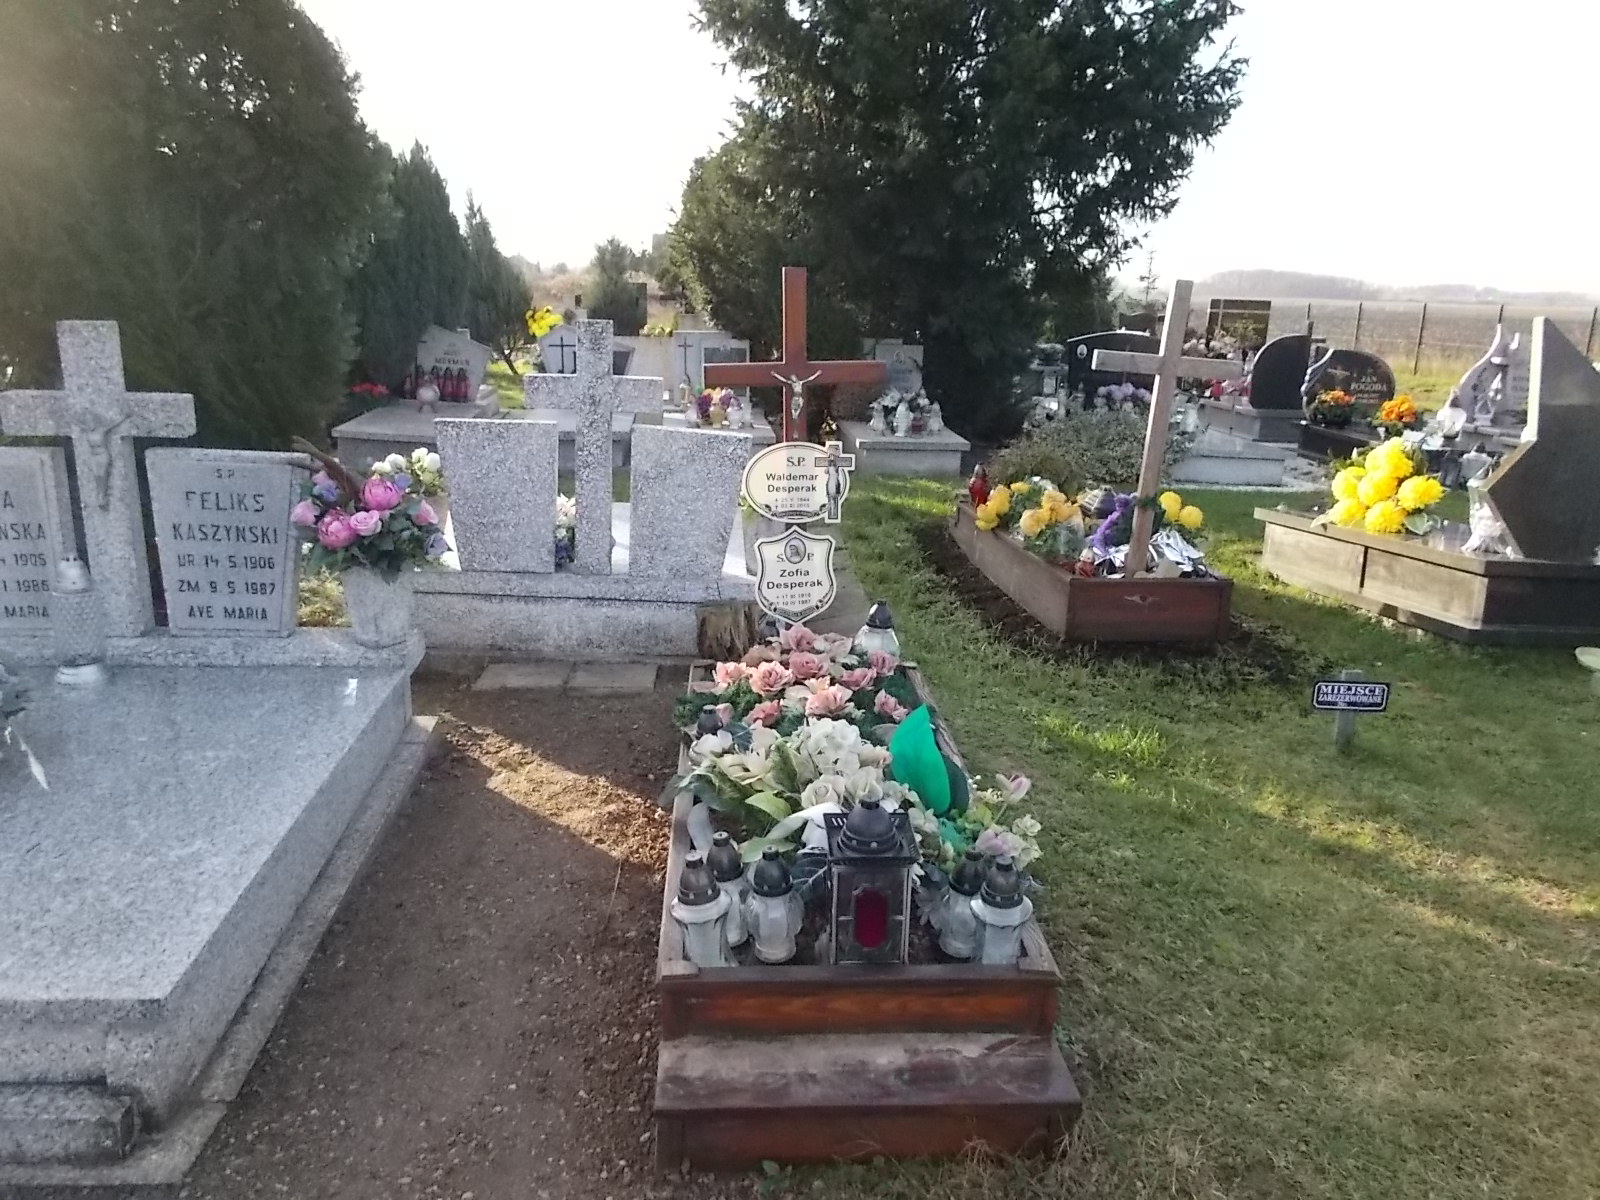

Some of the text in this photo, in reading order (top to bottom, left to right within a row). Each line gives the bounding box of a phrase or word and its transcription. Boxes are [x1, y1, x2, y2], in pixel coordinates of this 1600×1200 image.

[1350, 382, 1387, 391] POGODA
[766, 473, 819, 481] Waldemar
[767, 484, 817, 494] Desperak
[185, 491, 265, 513] FELIKS
[13, 553, 47, 567] 1905
[780, 568, 810, 578] Zofia
[766, 579, 824, 590] Desperak
[4, 605, 50, 618] MARIA
[188, 605, 268, 620] AVE MARIA
[1320, 685, 1384, 696] MIEJSCE
[1318, 693, 1382, 704] ZAREZERWOWANE
